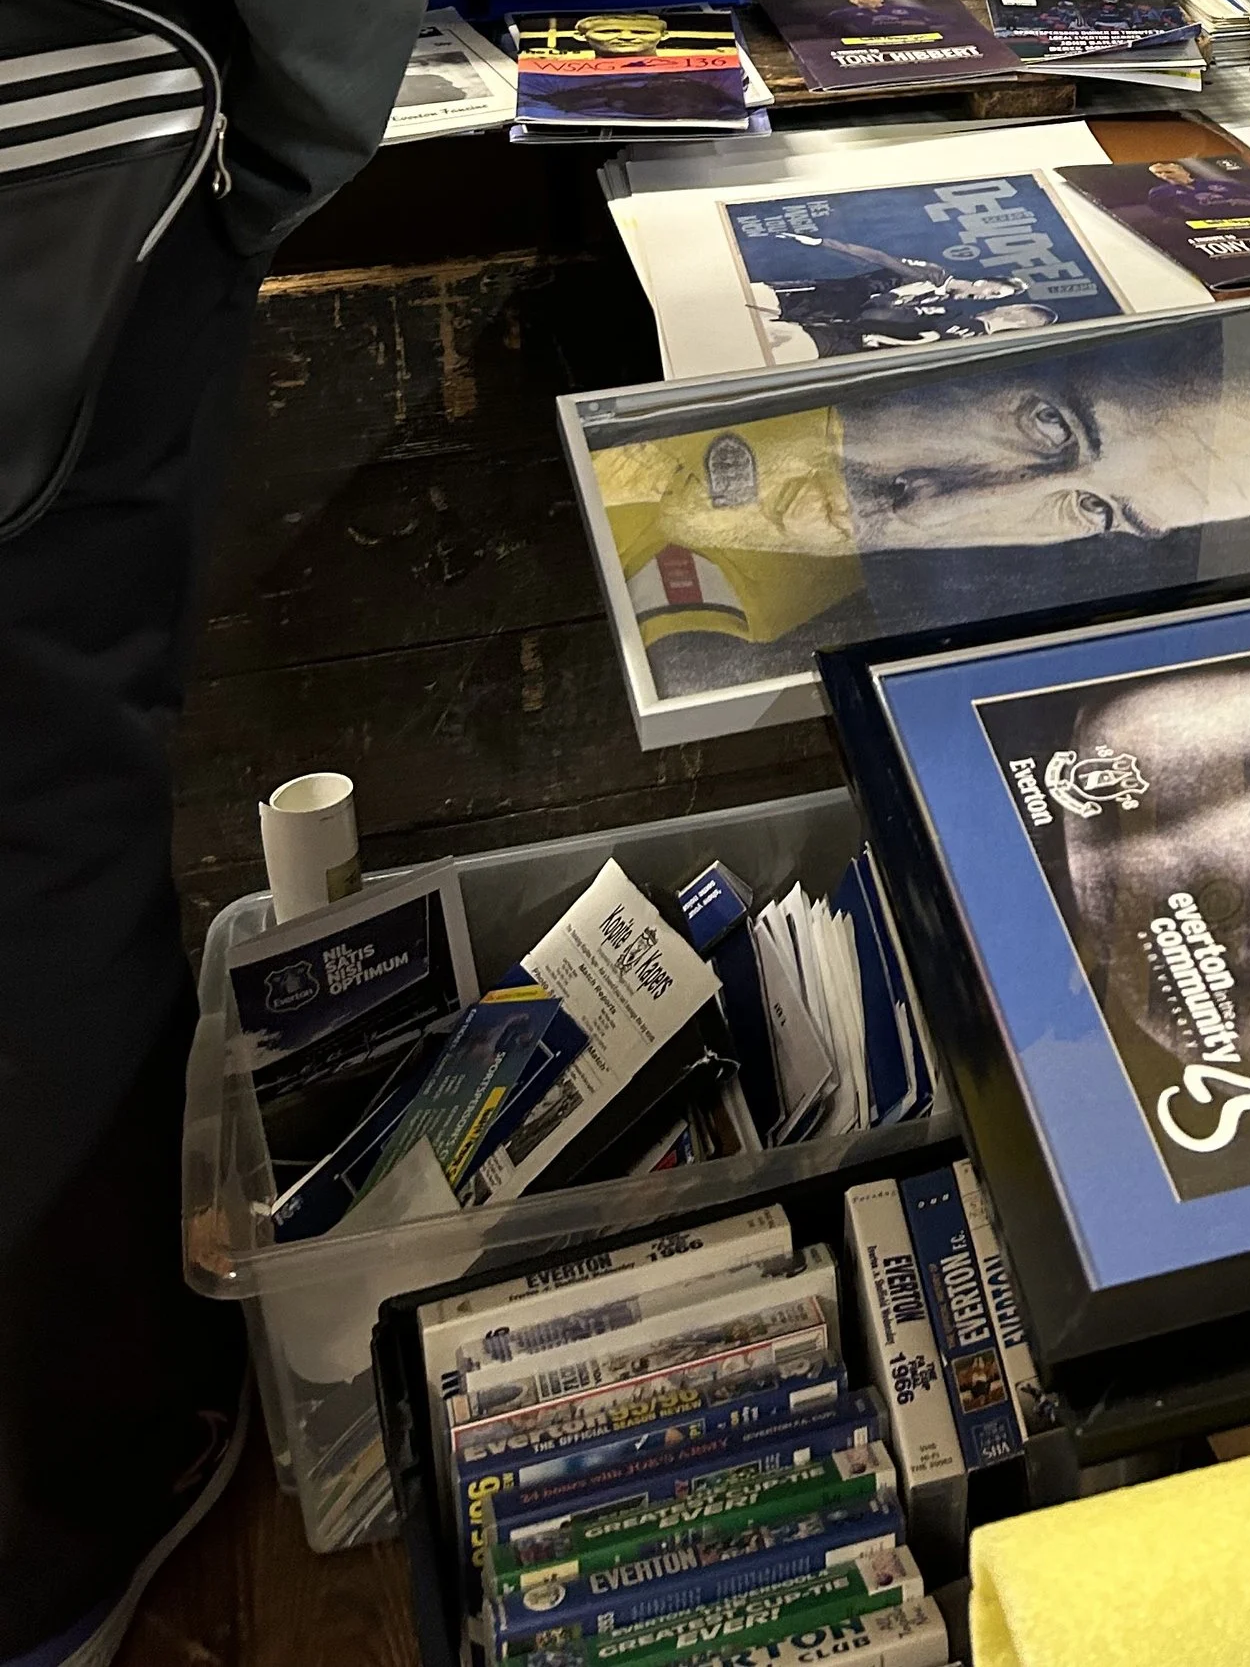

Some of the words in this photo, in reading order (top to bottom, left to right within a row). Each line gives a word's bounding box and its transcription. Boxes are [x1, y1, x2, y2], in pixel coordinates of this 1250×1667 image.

[531, 58, 616, 73] WSAG
[684, 56, 727, 69] 136
[834, 51, 885, 67] TONY
[888, 45, 980, 64] HIBBERT
[1198, 239, 1249, 257] TONY
[1095, 743, 1114, 759] 18
[1009, 757, 1053, 827] Everton
[322, 943, 352, 962] NIL
[324, 944, 376, 973] SATIS
[599, 902, 635, 951] Kopite
[635, 948, 674, 1001] Kapers
[1167, 891, 1236, 993] everton
[327, 963, 362, 984] NISI
[329, 952, 409, 996] OPTIMUM
[532, 967, 549, 991] Photo
[578, 964, 599, 991] Match
[595, 987, 618, 1016] Reports
[1137, 930, 1199, 1050] anniversary
[1150, 916, 1242, 1063] community
[273, 988, 314, 1009] Everton
[526, 1252, 612, 1289] EVERTON
[882, 1254, 925, 1325] EVERTON
[940, 1249, 990, 1348] EVERTON
[889, 1351, 915, 1406] 1966
[532, 1439, 556, 1455] THE
[558, 1427, 611, 1449] OFFICIAL
[612, 1410, 657, 1432] SEASON
[659, 1400, 701, 1420] REVIEW
[589, 1546, 699, 1595] EVERTON
[798, 1635, 873, 1664] CLUB
